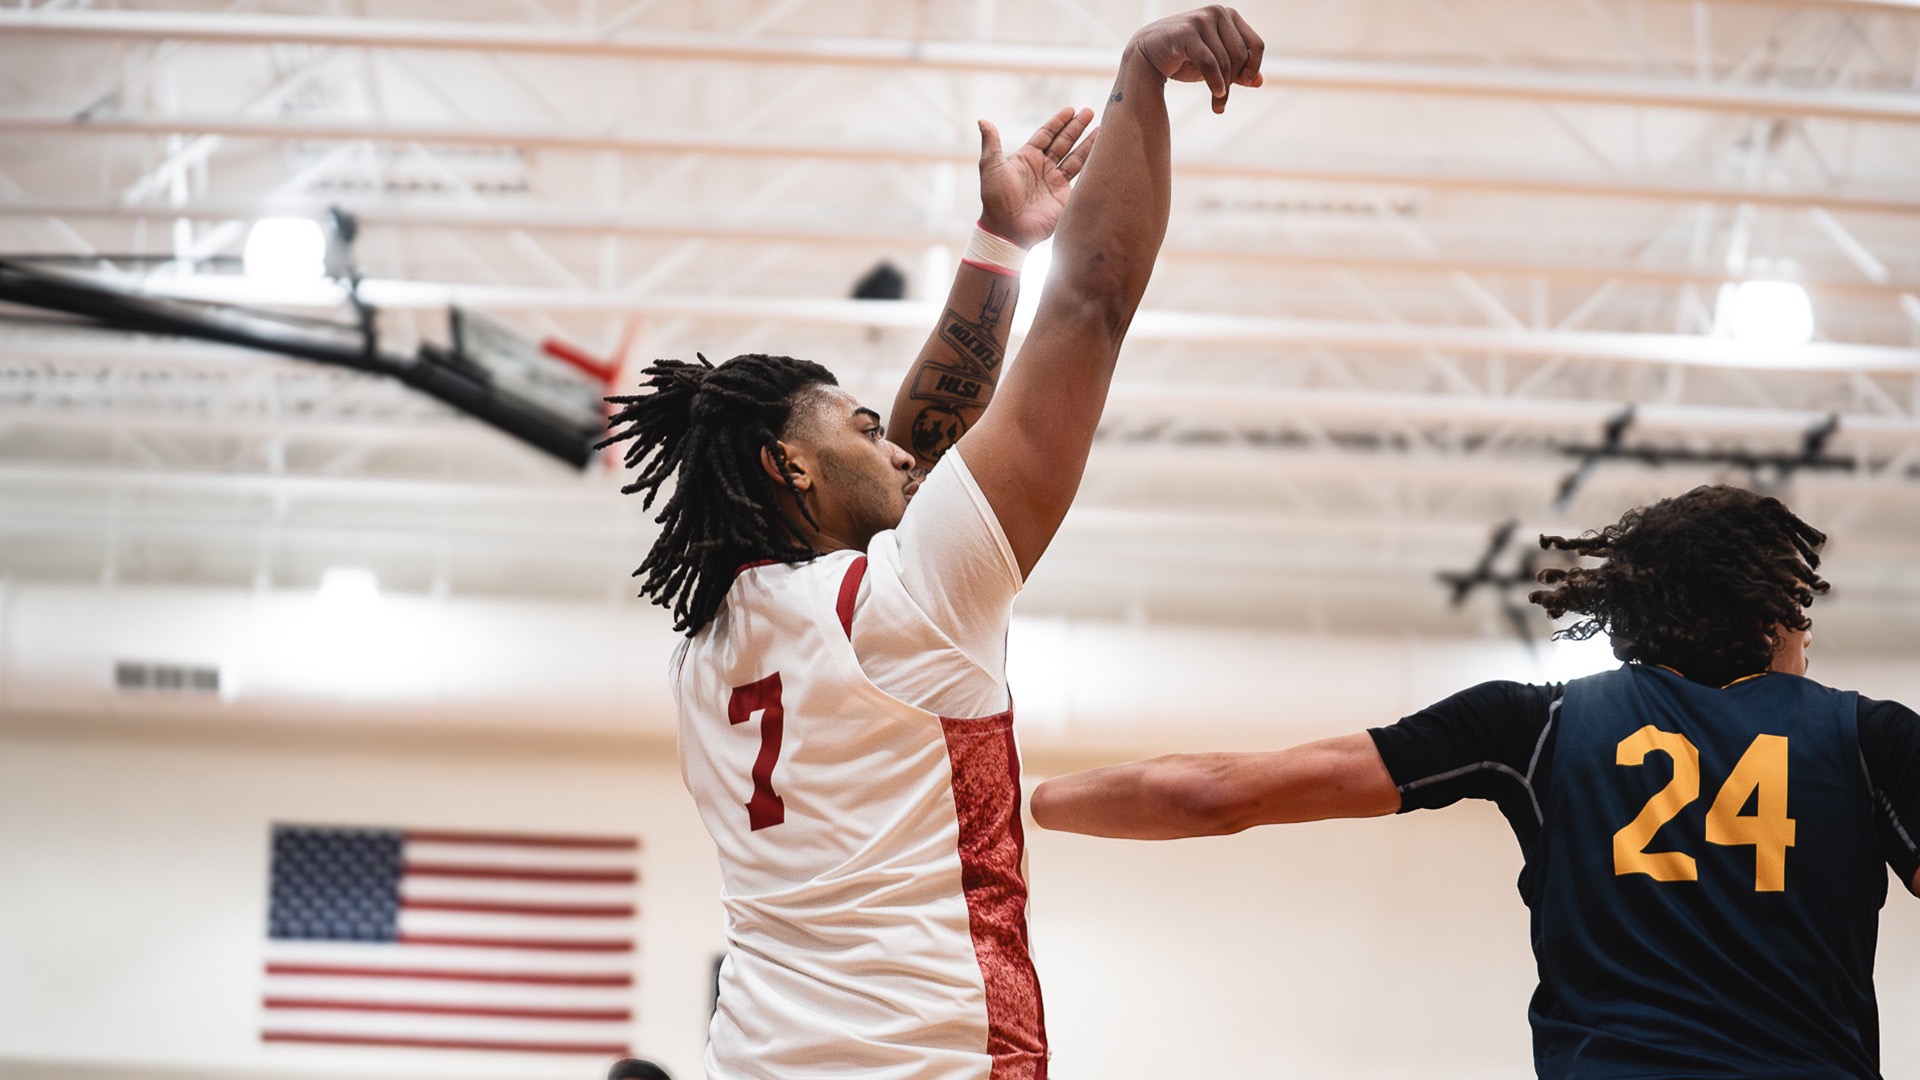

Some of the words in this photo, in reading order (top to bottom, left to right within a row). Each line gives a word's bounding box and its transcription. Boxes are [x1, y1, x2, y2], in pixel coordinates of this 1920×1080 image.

[947, 322, 1001, 371] FULTON
[728, 671, 785, 832] 7
[1613, 724, 1796, 892] 24
